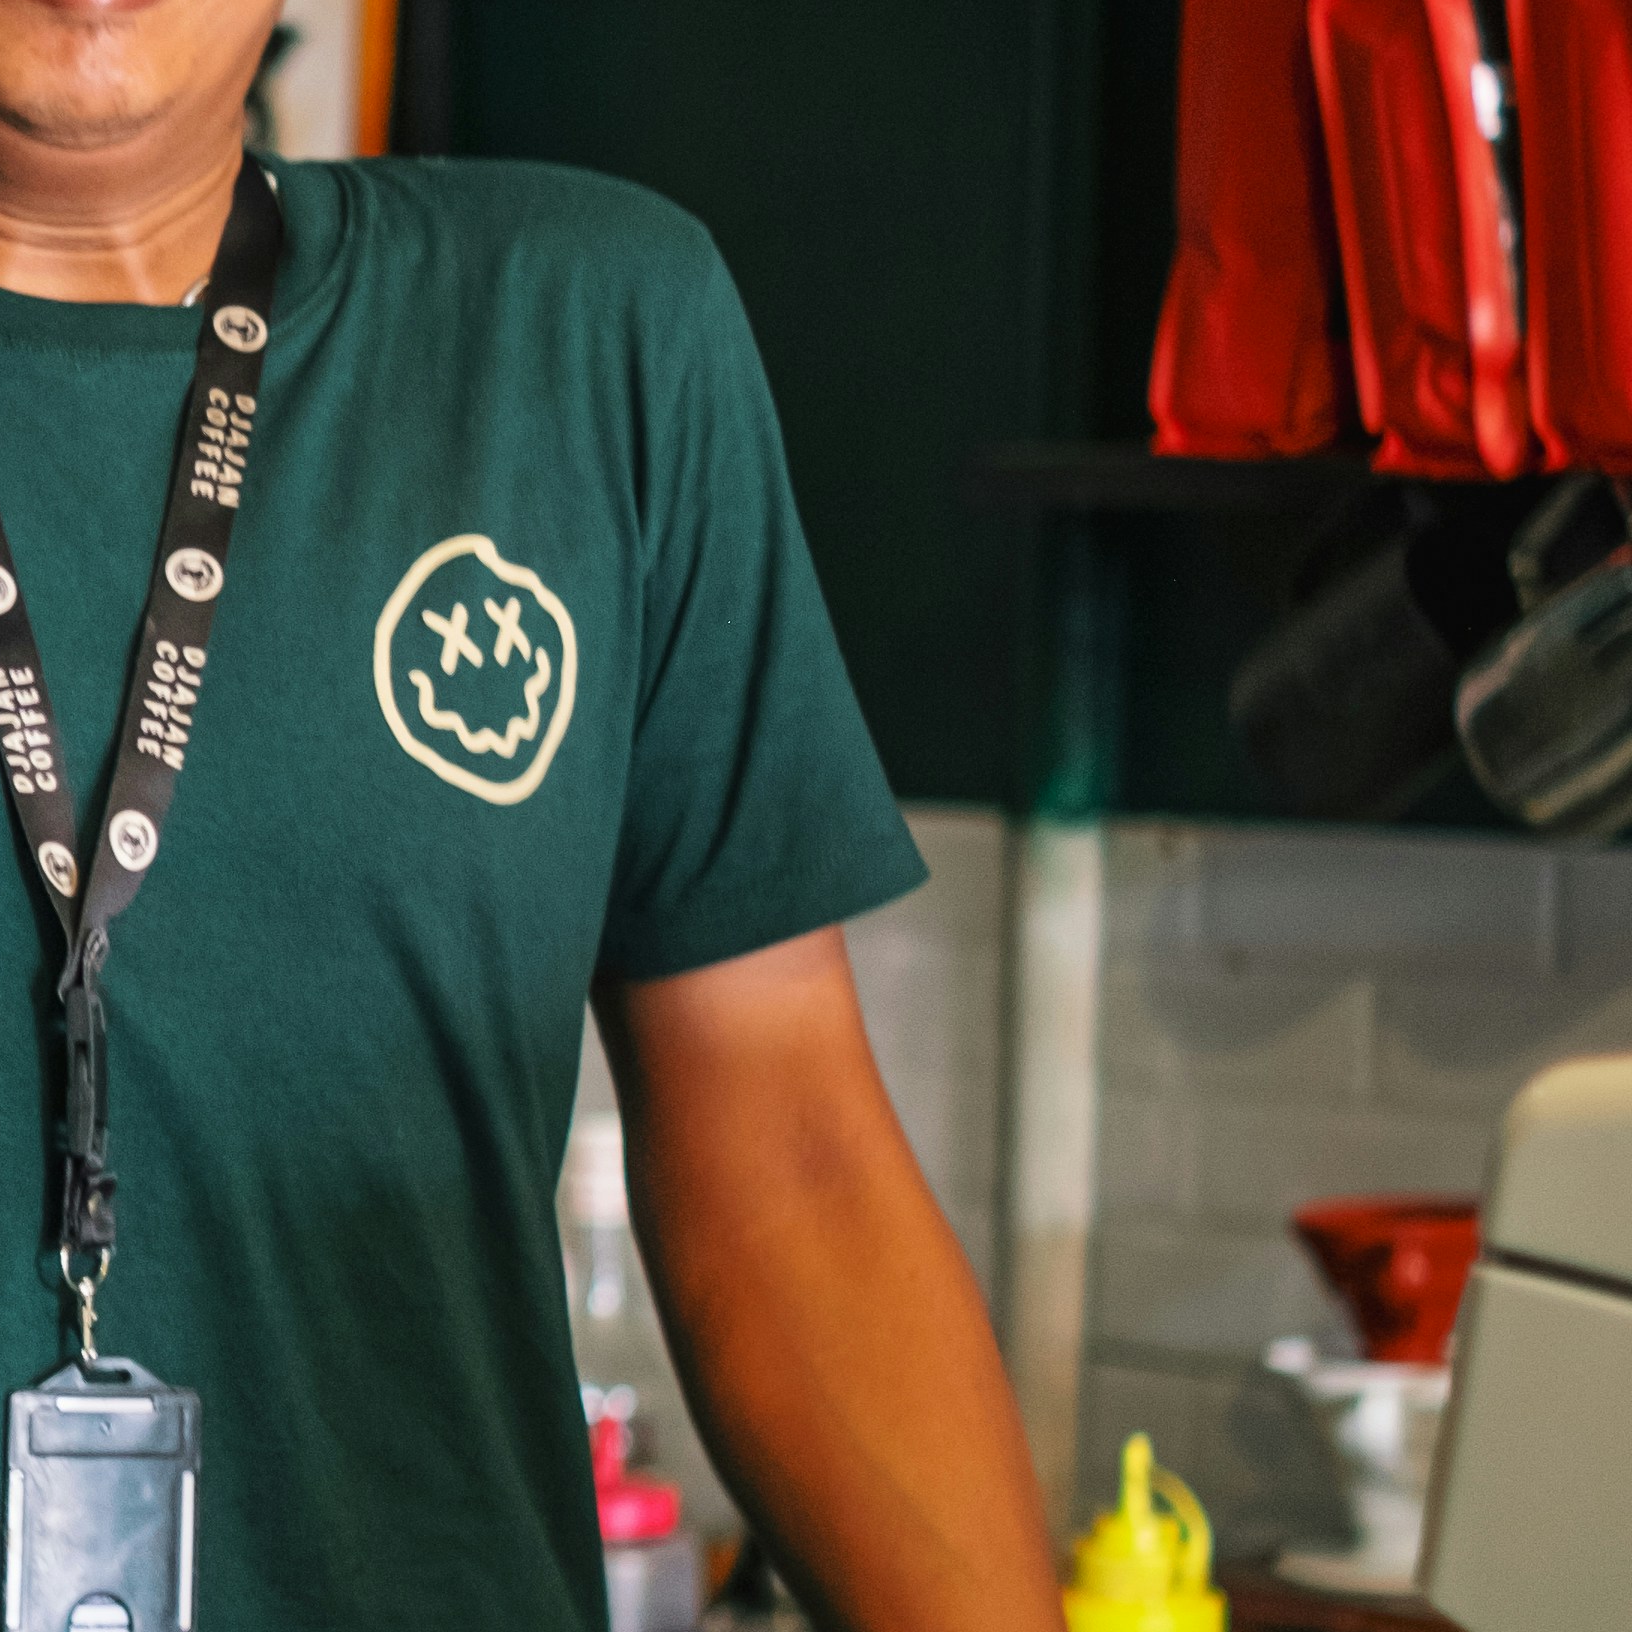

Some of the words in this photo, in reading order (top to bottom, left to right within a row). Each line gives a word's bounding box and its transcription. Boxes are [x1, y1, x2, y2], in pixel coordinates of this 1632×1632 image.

[190, 387, 230, 502] COFFEE
[217, 393, 256, 509] DJAJAN
[9, 666, 58, 793] COFFEE
[136, 639, 179, 760] COFFEE
[161, 645, 207, 772] DJAJAN
